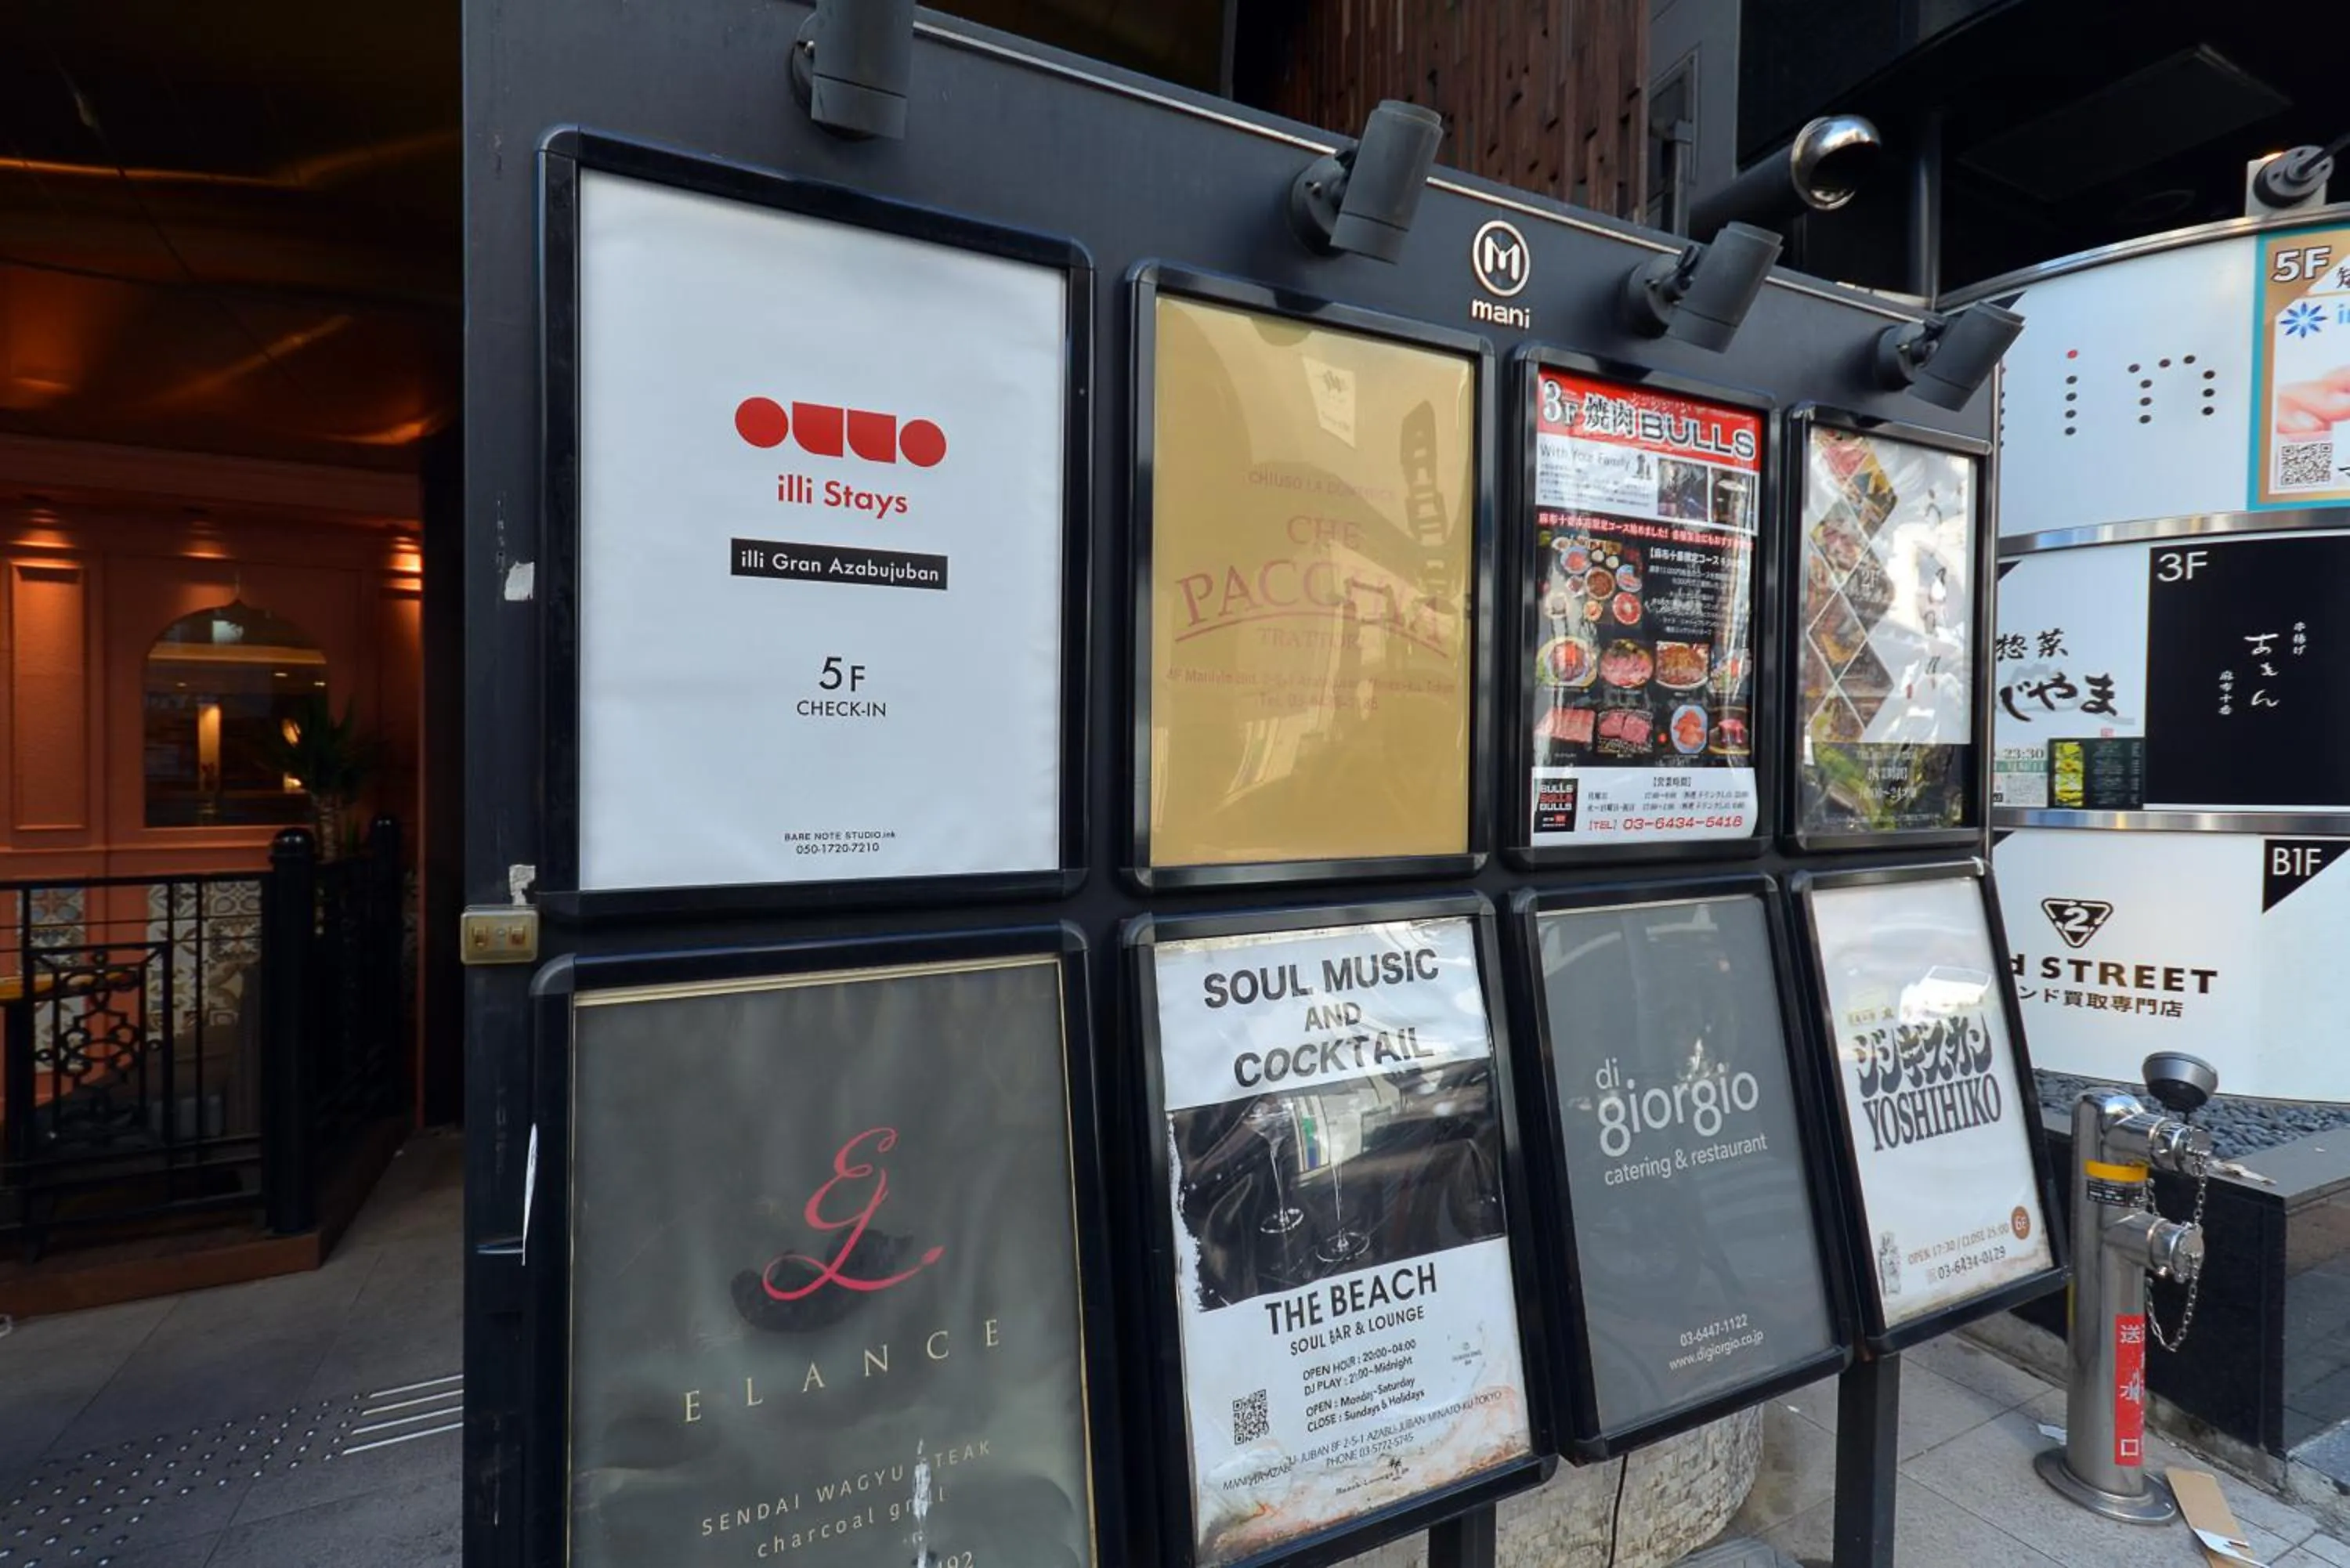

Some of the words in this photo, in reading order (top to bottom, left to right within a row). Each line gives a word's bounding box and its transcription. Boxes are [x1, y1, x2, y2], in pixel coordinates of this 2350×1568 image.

[2271, 245, 2331, 282] 5F
[1472, 298, 1530, 329] mani
[1638, 408, 1755, 461] BULLS
[778, 475, 812, 504] illi
[823, 480, 909, 519] Stays
[741, 551, 765, 569] illi
[772, 553, 822, 573] Gran
[829, 558, 939, 583] Azabujuban
[2157, 551, 2209, 582] 3F
[1996, 628, 2069, 661] 惣菜
[819, 656, 866, 692] 5F
[797, 700, 887, 717] CHECK-IN
[784, 833, 811, 842] BARE
[814, 833, 841, 841] NOTE
[2272, 847, 2321, 876] B1F
[1203, 964, 1313, 1009] SOUL
[1321, 948, 1439, 993] MUSIC
[2041, 956, 2218, 995] STREET
[1304, 1002, 1362, 1031] AND
[1234, 1027, 1435, 1088] COCKTAIL
[1596, 1057, 1620, 1089] di
[1597, 1062, 1759, 1157] giorgio
[1862, 1073, 2003, 1151] YOSHIHIKO
[1604, 1154, 1671, 1185] catering
[1675, 1147, 1688, 1168] &
[1691, 1133, 1768, 1165] restaurant
[1265, 1290, 1324, 1335] THE
[1331, 1262, 1437, 1318] BEACH
[1290, 1333, 1325, 1356] SOUL
[1329, 1322, 1351, 1344] BAR
[1355, 1320, 1365, 1335] &
[1368, 1306, 1425, 1332] LOUNGE
[1679, 1313, 1748, 1346] 03-6447-1122
[1668, 1329, 1764, 1371] www.digiorgio.co.jp
[684, 1319, 1000, 1422] ELANCE
[1303, 1366, 1331, 1381] OPEN
[1332, 1357, 1356, 1374] HOUR
[1304, 1384, 1315, 1396] DJ
[1317, 1378, 1342, 1391] PLAY
[1306, 1400, 1332, 1417] OPEN
[1307, 1414, 1337, 1433] CLOSE
[1344, 1404, 1380, 1421] Sundays
[1389, 1389, 1425, 1406] Holidays
[1325, 1450, 1358, 1468] PHONE
[701, 1494, 801, 1537] SENDAI
[816, 1465, 905, 1504] WAGYU
[935, 1440, 992, 1468] TEAK
[757, 1507, 874, 1559] charcoal
